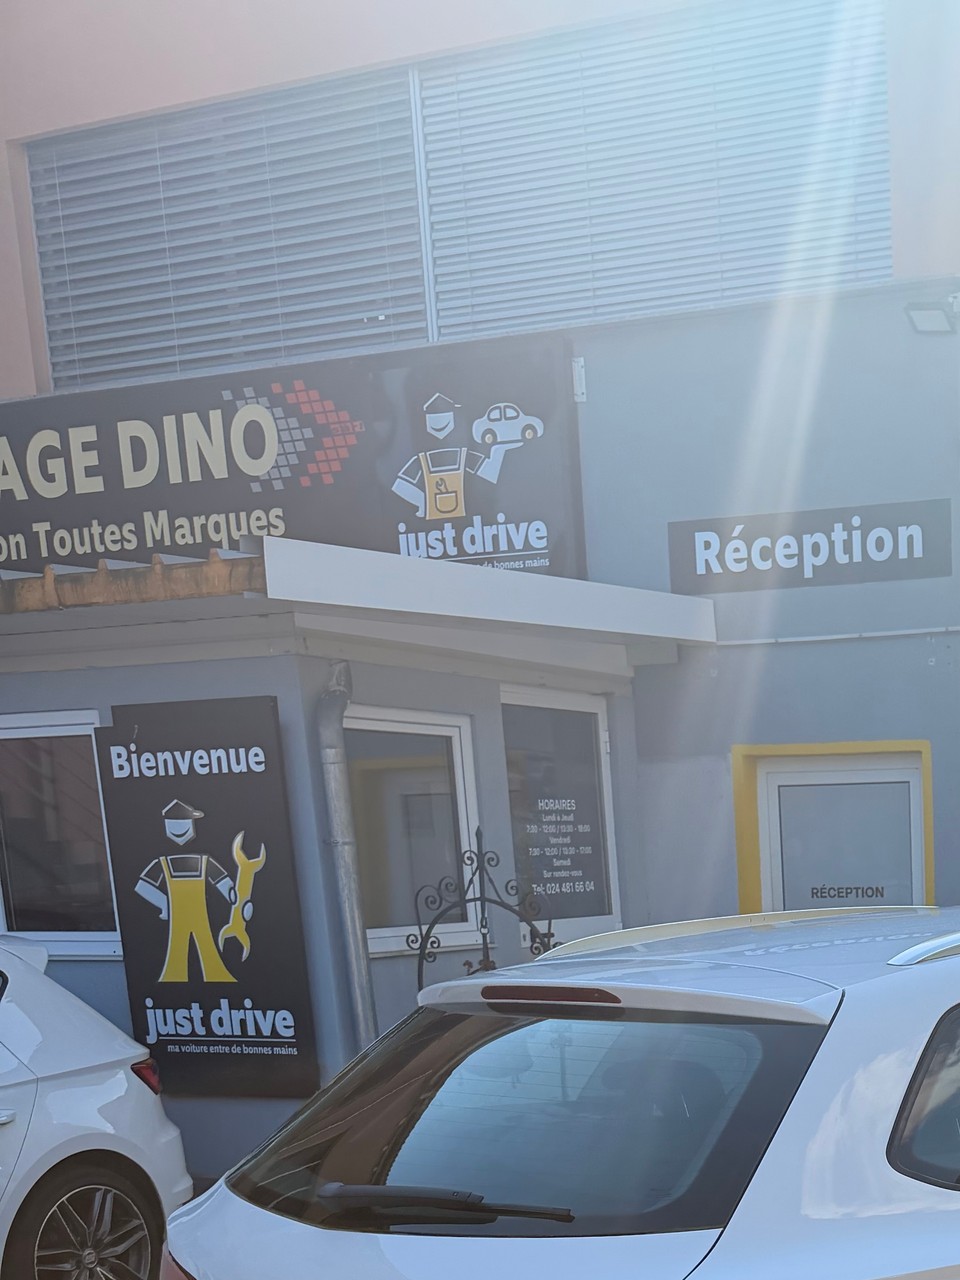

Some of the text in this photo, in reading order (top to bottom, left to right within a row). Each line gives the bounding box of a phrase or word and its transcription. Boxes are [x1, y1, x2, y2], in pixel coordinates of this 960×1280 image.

[117, 404, 279, 489] DINO
[32, 519, 138, 558] Toutes
[143, 507, 286, 550] Marques
[398, 512, 548, 558] just drive
[694, 515, 923, 578] Réception
[493, 560, 524, 570] bonnes
[525, 557, 550, 568] mains
[110, 743, 266, 779] Bienvenue
[538, 799, 576, 810] HORAIRES
[546, 883, 560, 894] 024
[561, 882, 574, 893] 481
[585, 880, 595, 892] 04
[810, 884, 885, 899] RÉCEPTION
[145, 997, 295, 1045] just drive
[167, 1043, 298, 1055] ma voiture entre de bonnes mains
